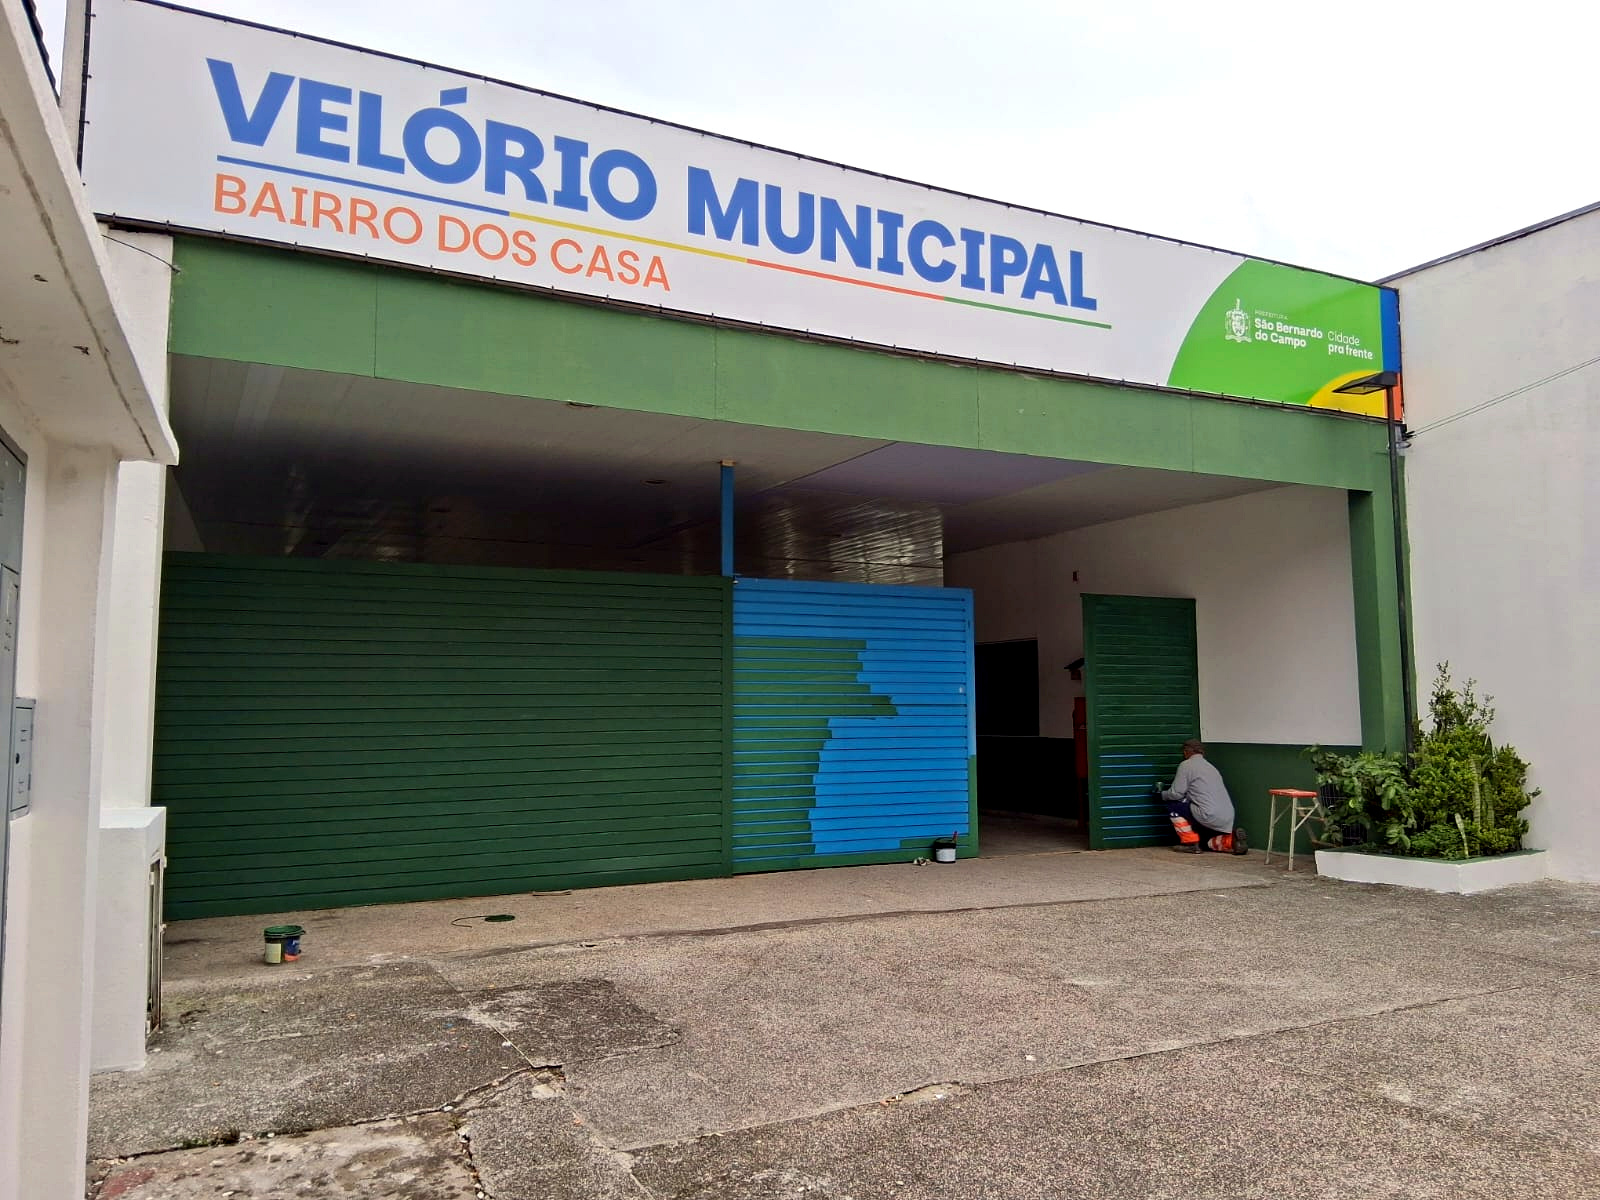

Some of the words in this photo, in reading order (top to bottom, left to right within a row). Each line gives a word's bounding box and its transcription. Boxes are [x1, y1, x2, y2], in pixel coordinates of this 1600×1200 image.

[206, 57, 658, 221] VELÓRIO
[688, 165, 1098, 311] MUNICIPAL
[213, 173, 424, 246] BAIRRO
[438, 215, 538, 267] DOS
[550, 237, 671, 292] CASA
[1254, 318, 1274, 331] São
[1276, 321, 1324, 339] Bernardo
[1254, 331, 1268, 341] do
[1270, 333, 1307, 349] Campo
[1327, 331, 1360, 346] Cidade
[1328, 343, 1344, 355] pra
[1345, 345, 1374, 360] frente
